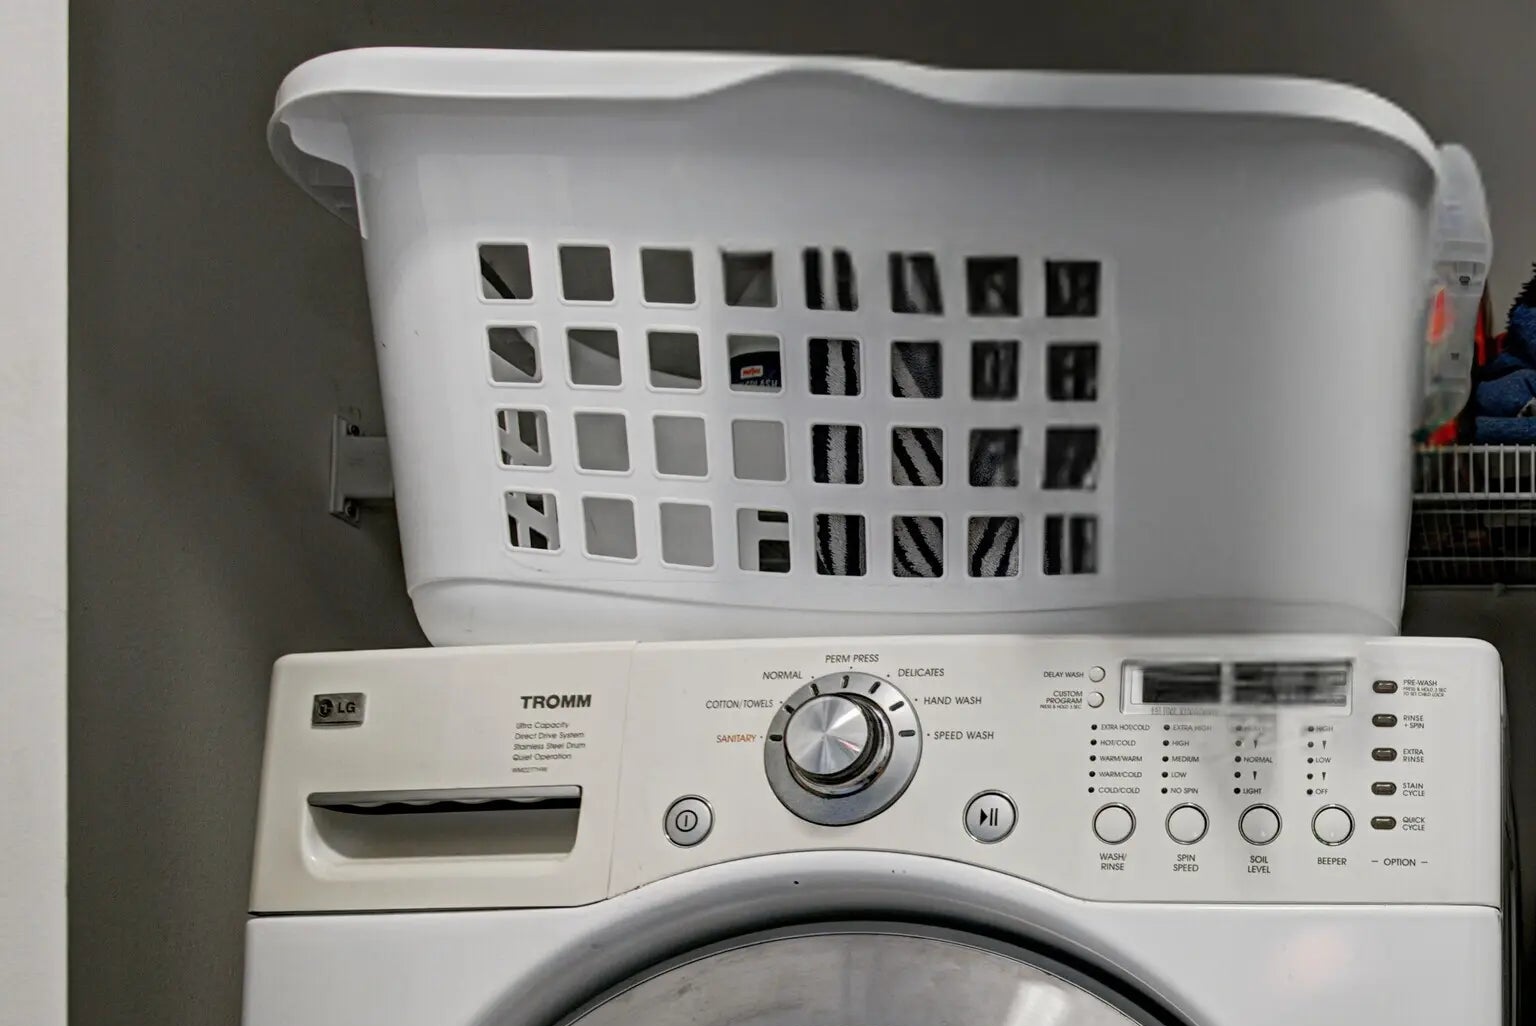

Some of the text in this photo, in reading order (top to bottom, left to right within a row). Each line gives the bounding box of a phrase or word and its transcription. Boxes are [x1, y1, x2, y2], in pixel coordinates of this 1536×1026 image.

[825, 654, 879, 663] PERM PRESS
[762, 671, 803, 680] NORMAL
[898, 668, 946, 678] DELICATES
[520, 694, 592, 709] TROMM
[705, 699, 773, 709] COTTON/TOWELS
[923, 696, 982, 705] HAND WASH
[338, 702, 356, 713] LG
[534, 721, 569, 729] Capacity
[559, 731, 585, 739] System
[716, 734, 756, 743] SANITARY
[934, 731, 994, 740] SPEED WASH
[1100, 853, 1127, 861] WASH/
[1177, 854, 1196, 862] SPIN
[1250, 856, 1268, 864] SOIL
[1317, 858, 1347, 866] BEEPER
[1384, 858, 1416, 866] OPTION
[1173, 864, 1199, 872] SPEED
[1247, 866, 1271, 874] LEVEL
